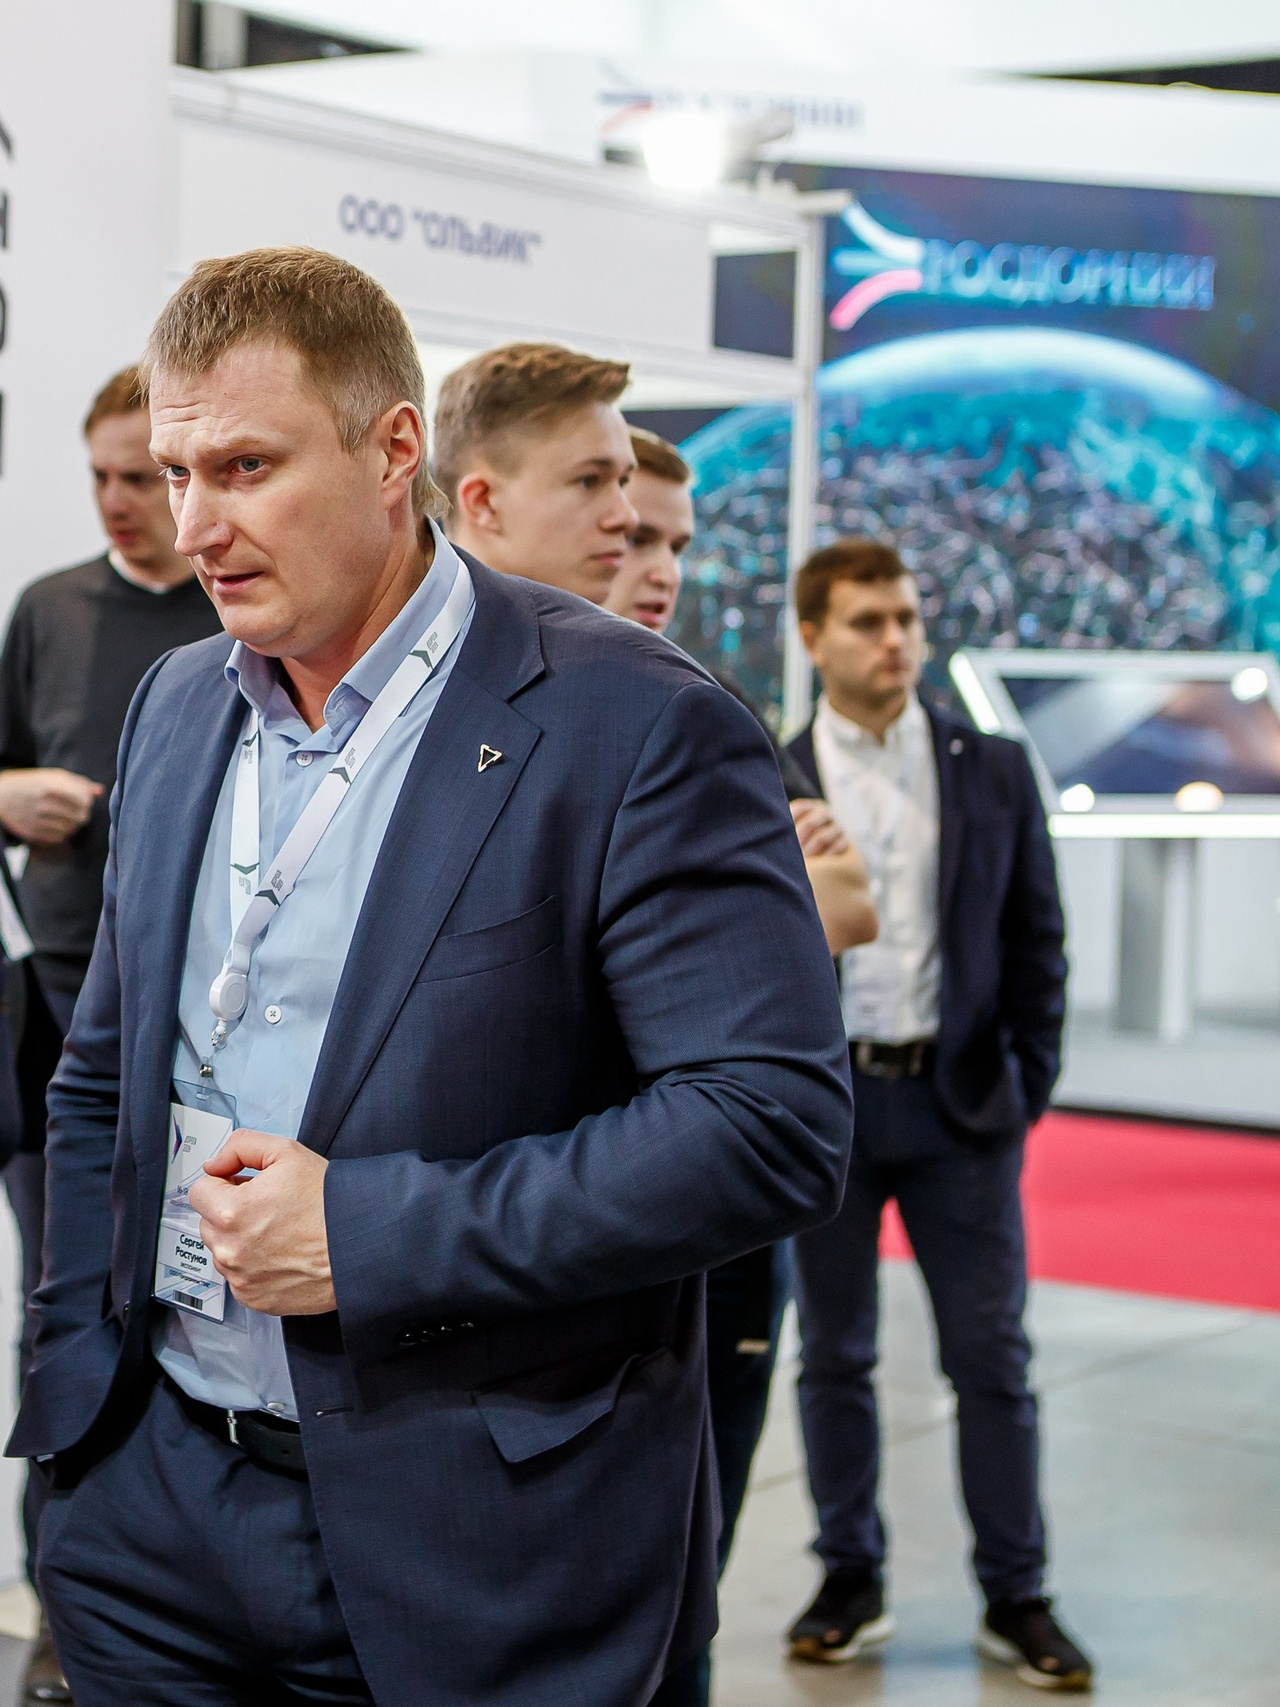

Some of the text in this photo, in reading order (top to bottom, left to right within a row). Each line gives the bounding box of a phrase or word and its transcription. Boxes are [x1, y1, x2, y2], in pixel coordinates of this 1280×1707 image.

[339, 194, 404, 241] ООО
[180, 1234, 205, 1251] Сергей
[175, 1246, 208, 1266] Ростунов
